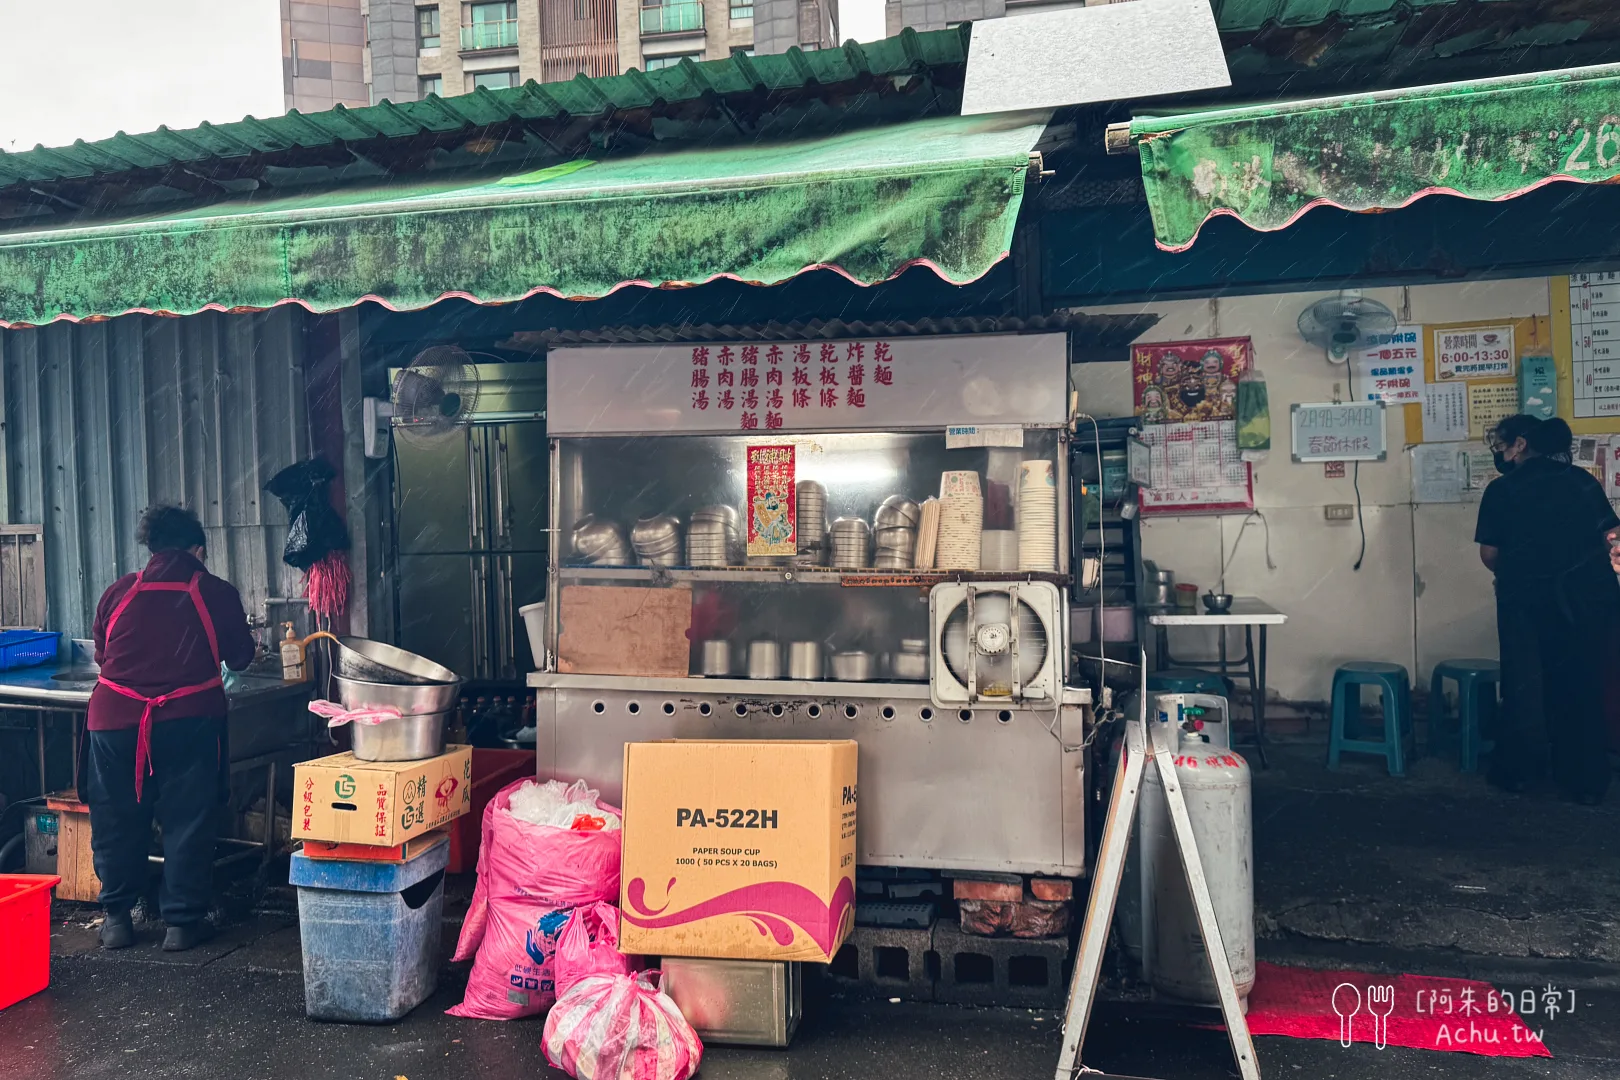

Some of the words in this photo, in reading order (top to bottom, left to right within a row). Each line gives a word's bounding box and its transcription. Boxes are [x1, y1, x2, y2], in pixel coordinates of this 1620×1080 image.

[874, 341, 893, 386] 乾麵
[1367, 348, 1417, 359] 一個五元
[1441, 349, 1509, 363] 6:00-13:30
[1444, 334, 1478, 349] 營業時間
[691, 346, 710, 410] 豬腸湯
[717, 346, 735, 410] 赤肉湯
[740, 345, 759, 430] 豬腸湯麵
[765, 344, 784, 430] 赤肉湯麵
[792, 344, 812, 408] 湯板條
[819, 343, 839, 408] 乾板條
[846, 342, 866, 408] 炸醬麵
[1375, 378, 1411, 389] 不附碗
[1455, 362, 1509, 373] 賣完將提早打烊
[1300, 408, 1373, 428] 2月9日-3月4日
[1308, 435, 1371, 454] 春節休假
[303, 777, 315, 832] 分級包裝
[375, 783, 387, 837] 品質保証
[415, 775, 427, 824] 精選
[676, 808, 778, 829] PA-522H
[693, 847, 719, 855] PAPER
[744, 848, 761, 856] CUP
[703, 858, 713, 866] 50
[740, 859, 751, 867] 20
[752, 860, 778, 869] BAGS)
